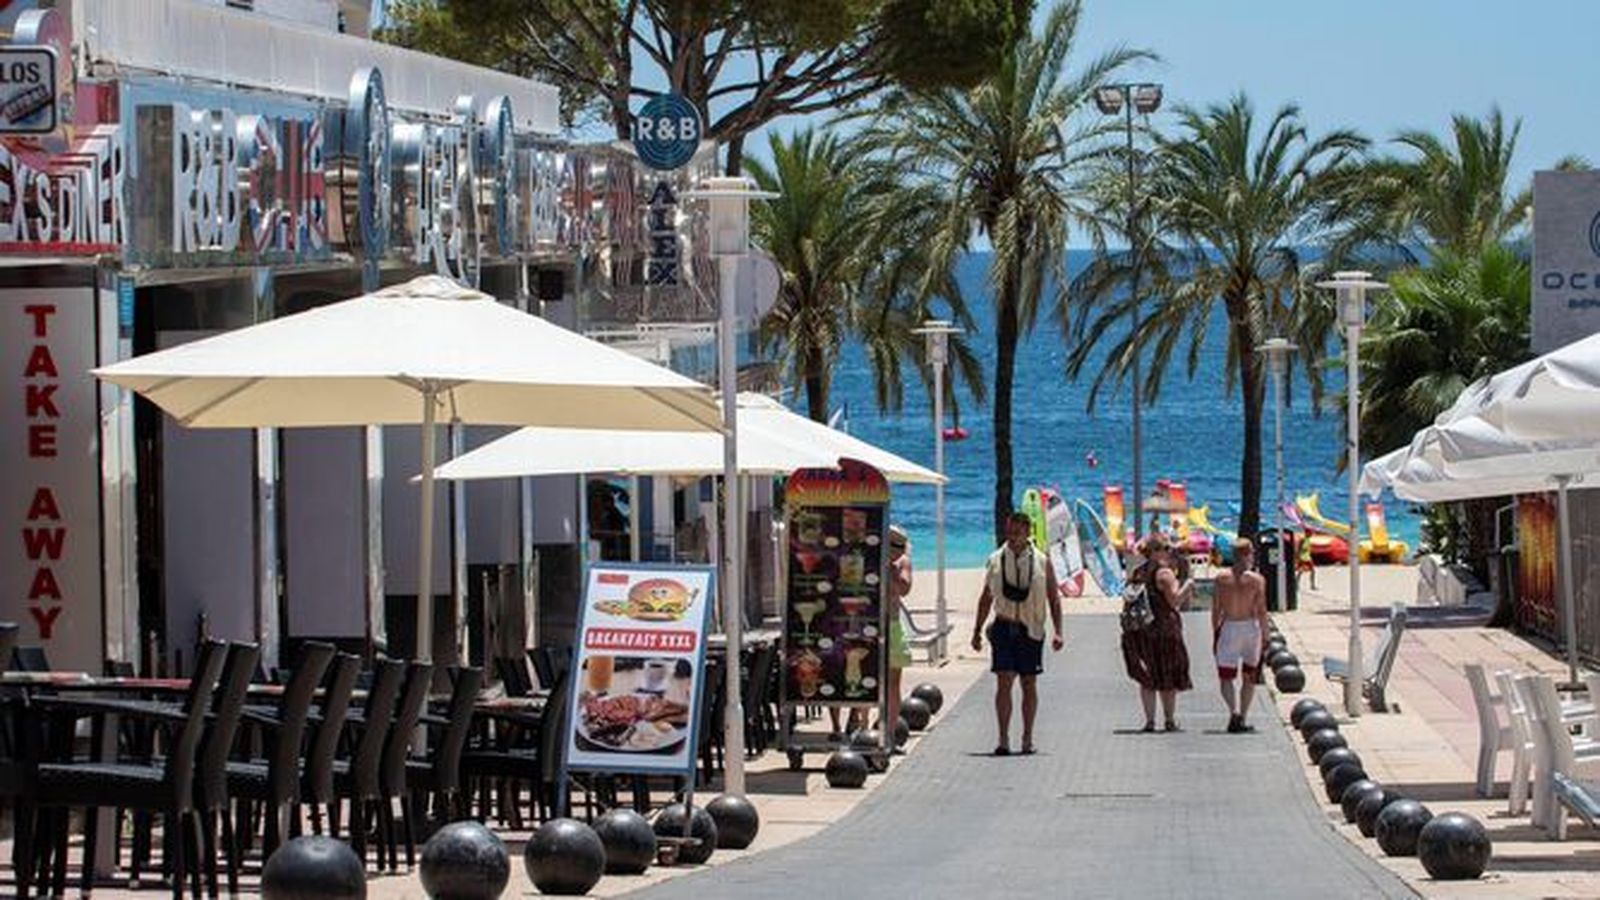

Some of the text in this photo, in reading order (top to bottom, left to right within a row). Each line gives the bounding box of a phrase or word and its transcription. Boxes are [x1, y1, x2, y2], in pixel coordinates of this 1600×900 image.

[173, 102, 240, 252] R&B
[637, 116, 697, 144] R&B
[59, 133, 127, 244] DINER
[648, 181, 678, 285] ALEX
[22, 305, 66, 640] TAKE AWAY
[588, 630, 692, 648] BREAKFAST XXXL
